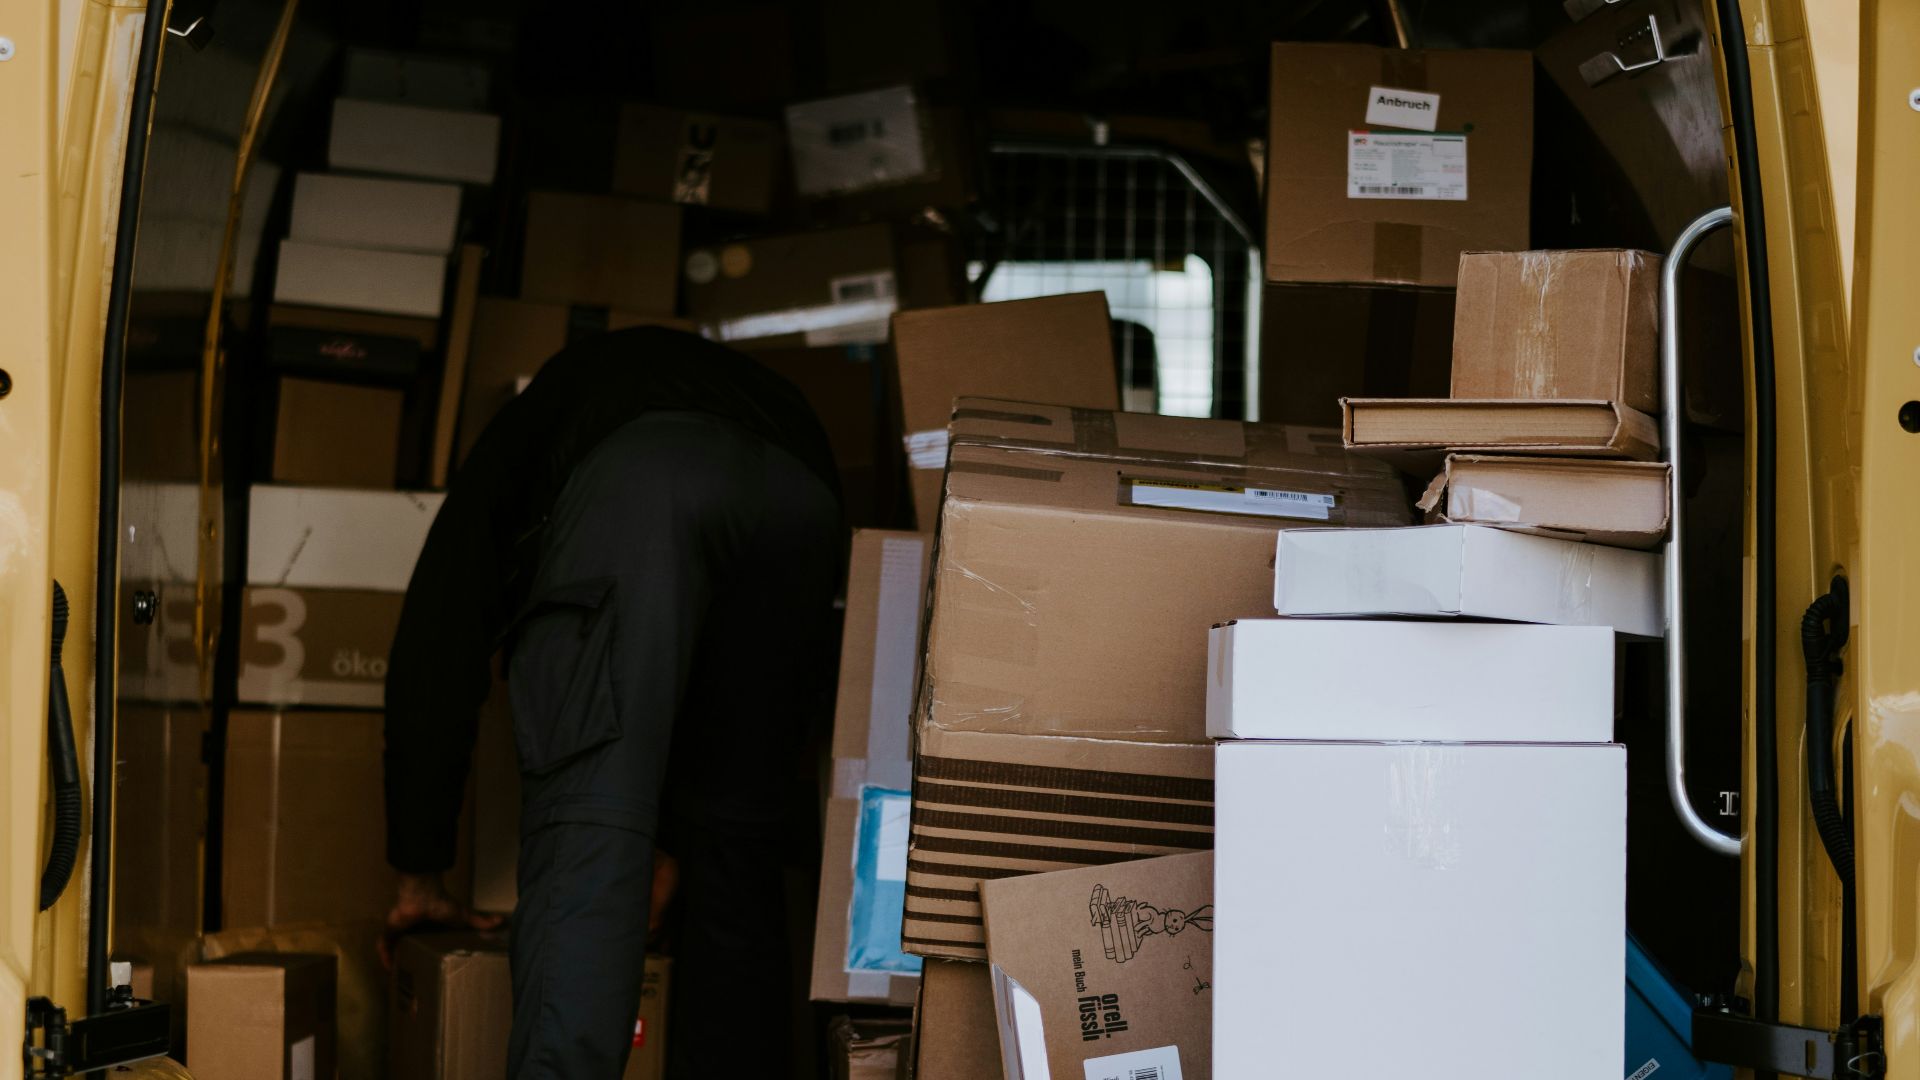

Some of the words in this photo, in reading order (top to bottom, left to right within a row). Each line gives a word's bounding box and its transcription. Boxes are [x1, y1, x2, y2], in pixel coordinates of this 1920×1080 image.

[1376, 95, 1431, 111] Anbruch
[1072, 949, 1084, 969] mein
[1075, 971, 1087, 992] Buch
[1078, 995, 1105, 1041] füssli
[1102, 993, 1128, 1038] orell.
